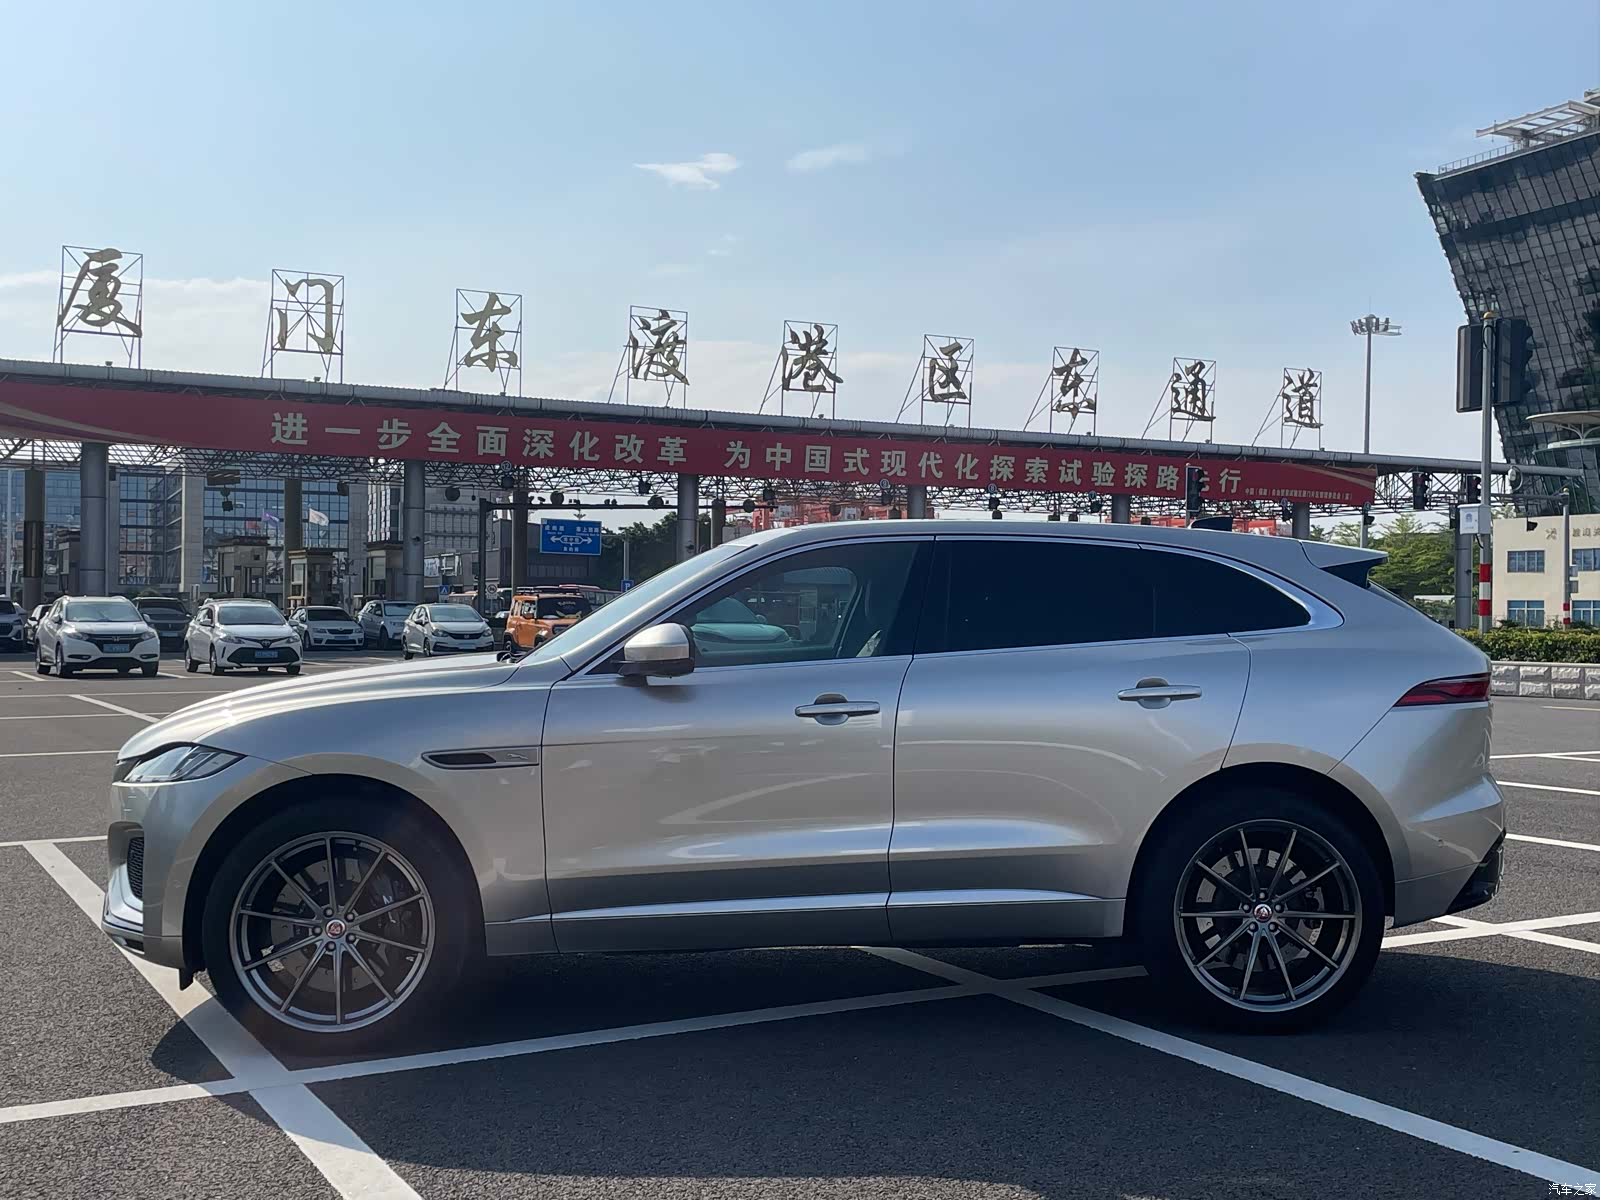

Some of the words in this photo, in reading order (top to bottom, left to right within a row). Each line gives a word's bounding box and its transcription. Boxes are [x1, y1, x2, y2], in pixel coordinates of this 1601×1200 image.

[271, 412, 688, 467] 进一步全面深化改革
